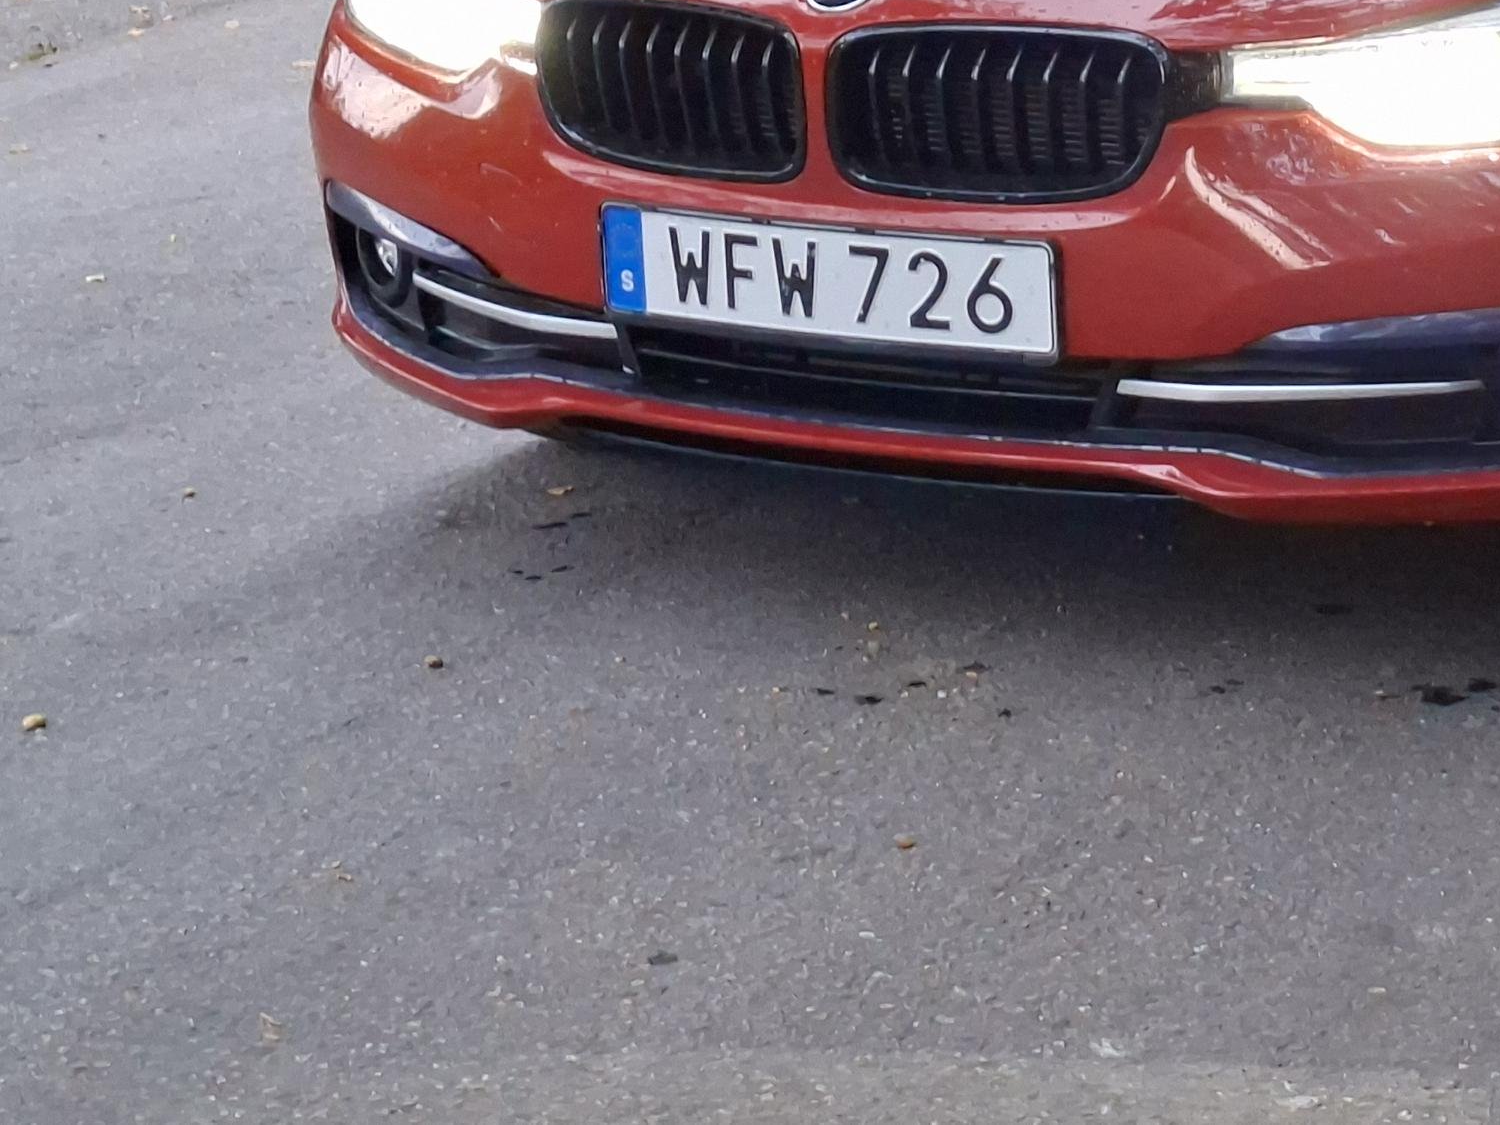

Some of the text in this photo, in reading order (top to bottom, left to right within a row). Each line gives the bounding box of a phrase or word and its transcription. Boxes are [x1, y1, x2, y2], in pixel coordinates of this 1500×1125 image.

[621, 269, 634, 292] S
[668, 226, 1014, 334] WFW 726
